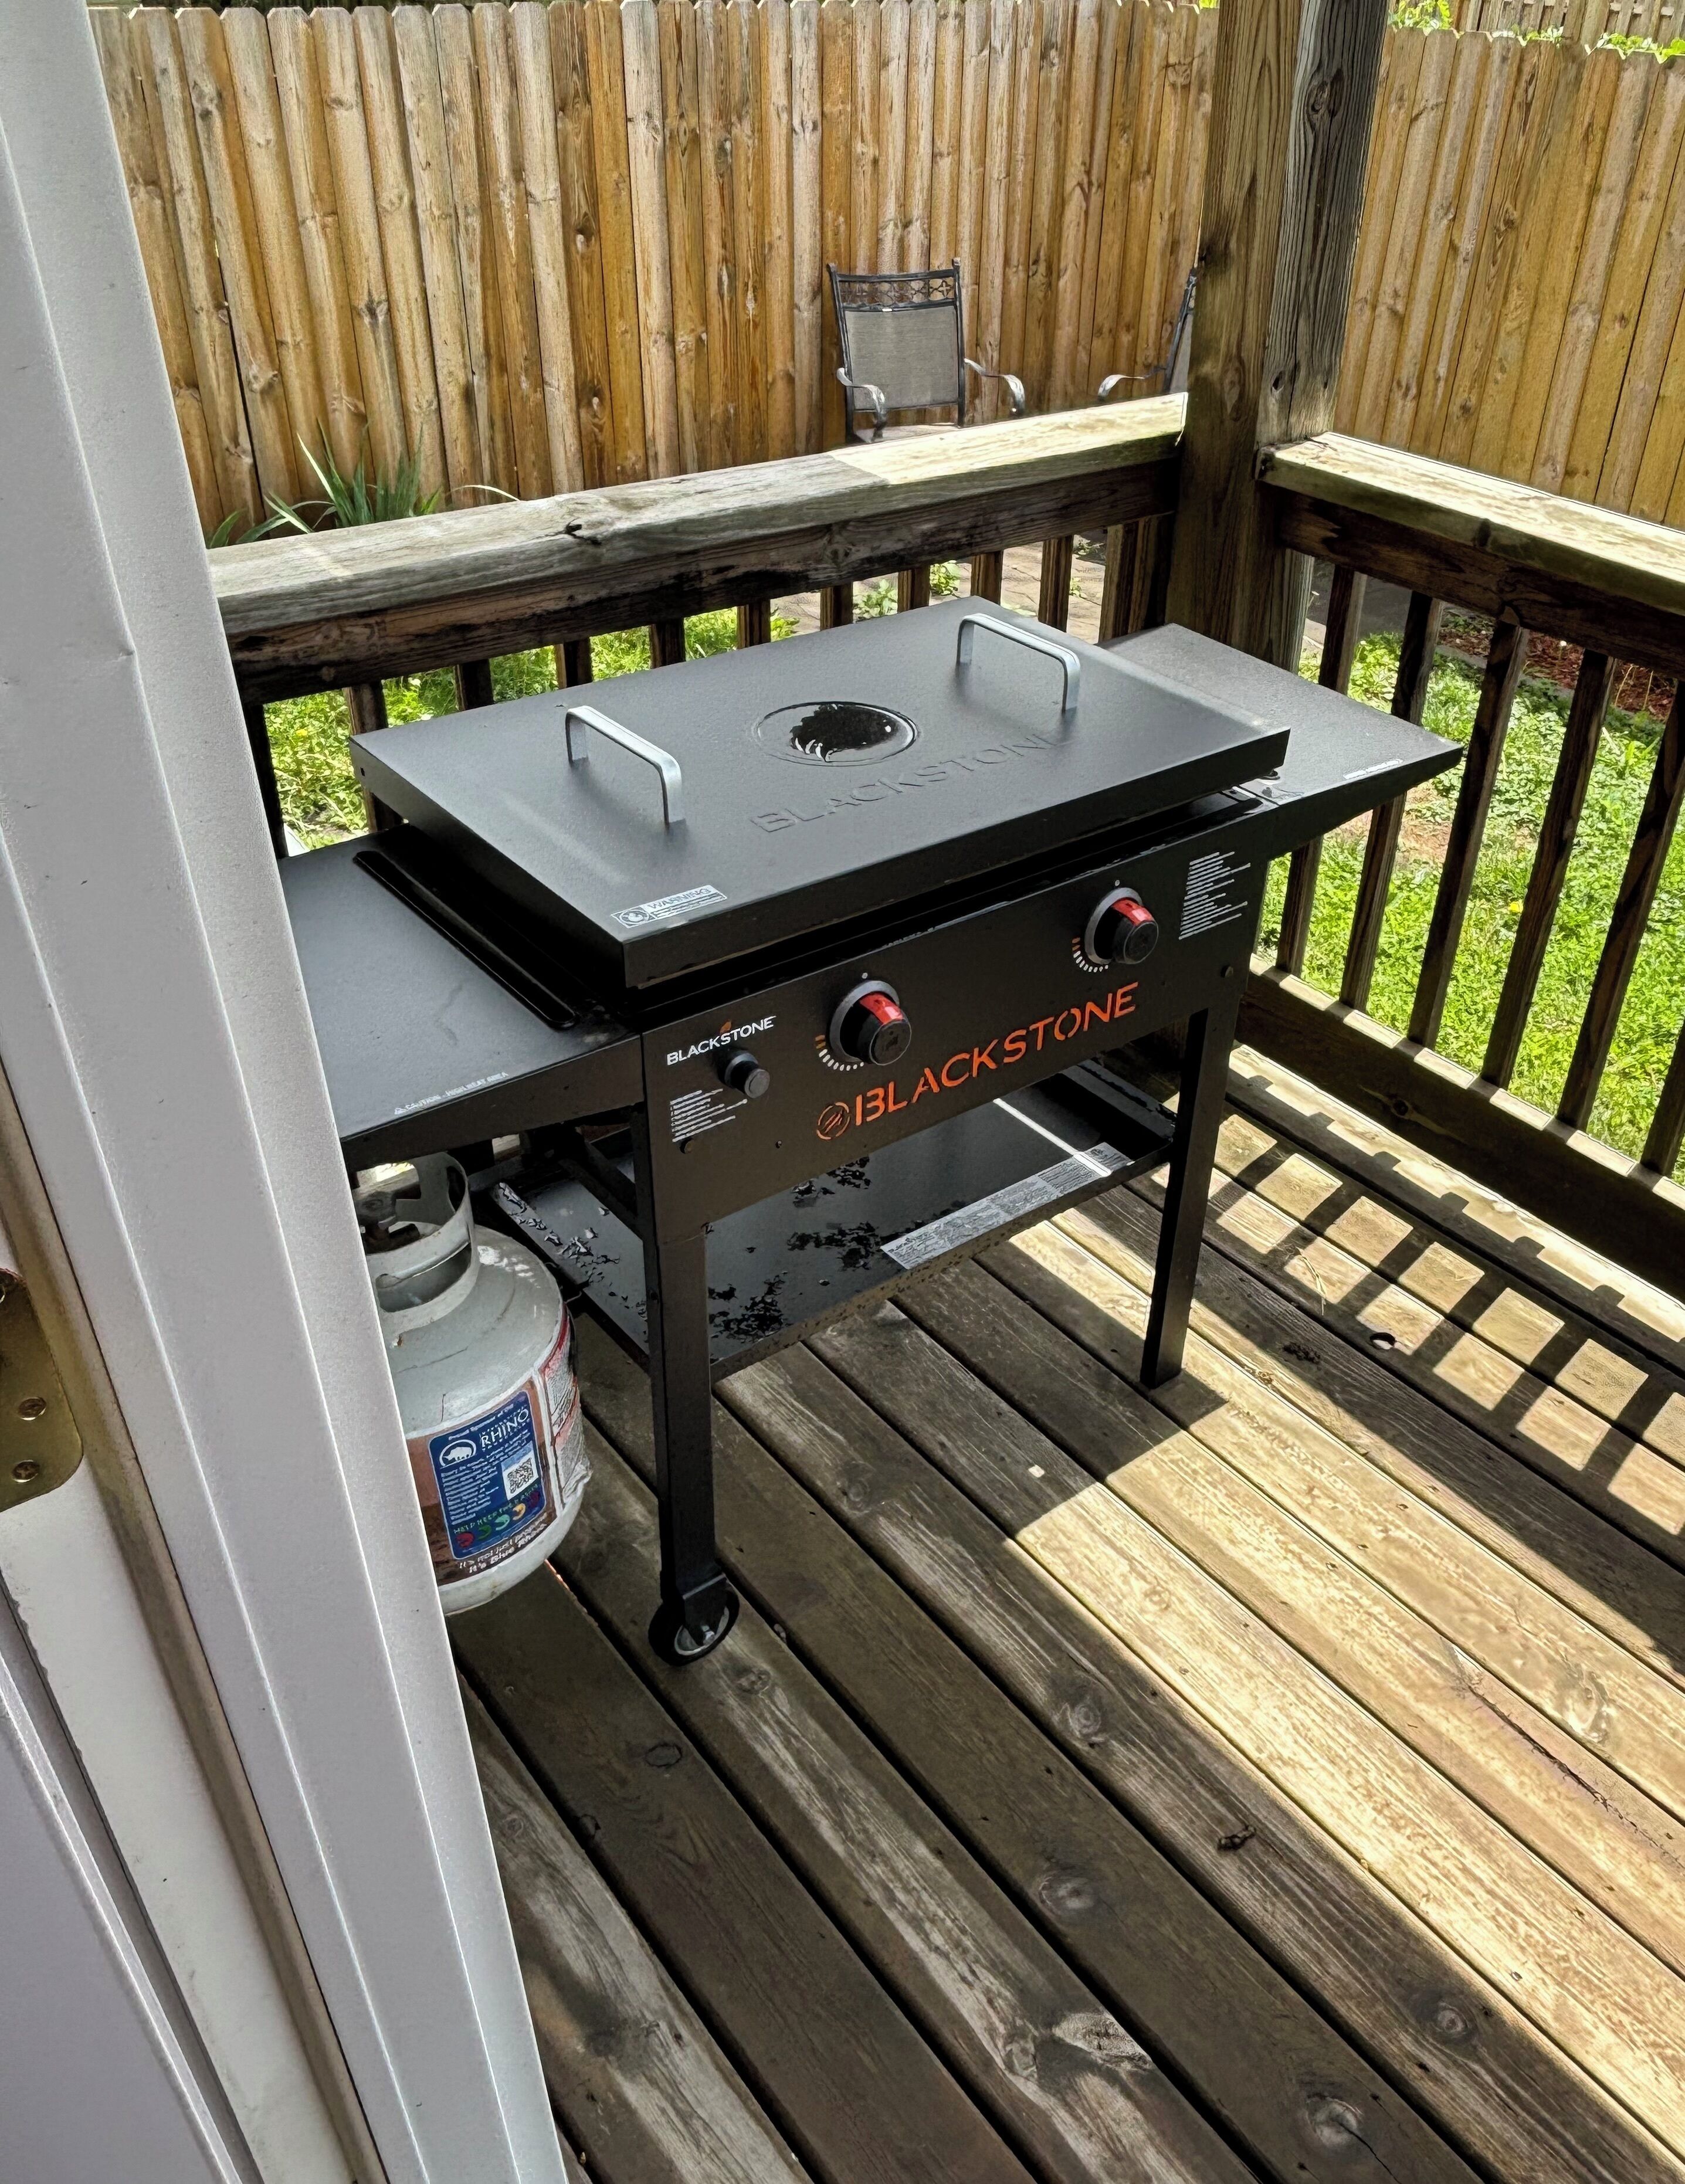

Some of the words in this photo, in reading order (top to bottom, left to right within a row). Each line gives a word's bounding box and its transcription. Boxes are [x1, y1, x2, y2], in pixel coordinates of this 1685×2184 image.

[751, 733, 1059, 833] BLACKSTON
[647, 887, 712, 910] WARNING
[667, 1015, 777, 1065] BLACKSTONE
[855, 981, 1139, 1126] BLACKSTONE
[480, 1408, 528, 1448] RHINO
